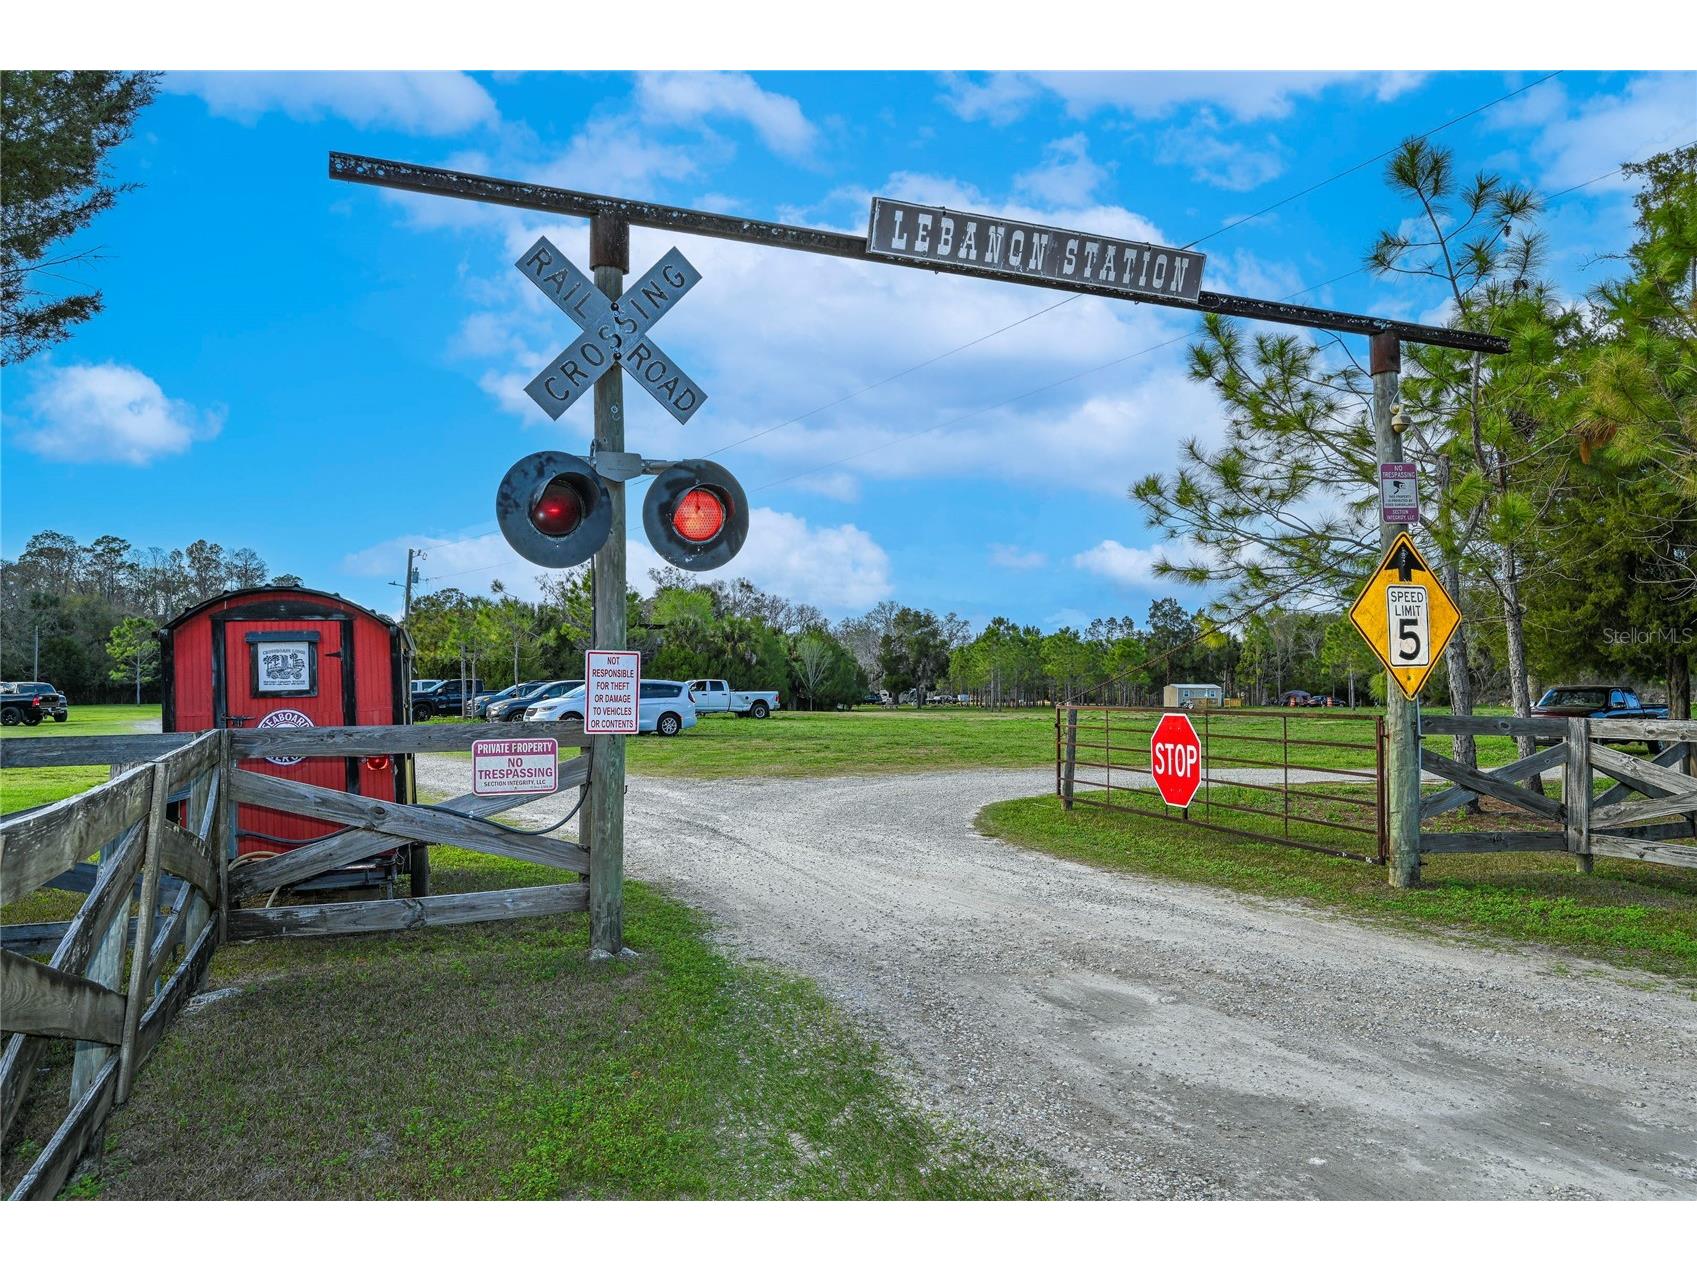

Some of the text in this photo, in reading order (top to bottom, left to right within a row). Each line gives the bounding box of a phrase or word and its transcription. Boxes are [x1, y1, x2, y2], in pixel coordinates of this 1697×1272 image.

[891, 210, 1190, 293] LEBANON STATION
[526, 247, 696, 412] RAIL ROAD
[544, 264, 685, 401] CROSSING
[1390, 591, 1424, 603] SPEED
[1395, 605, 1421, 617] LIMIT
[1398, 618, 1421, 661] 5
[607, 656, 620, 665] NOT
[592, 669, 634, 678] RESPONSIBLE
[596, 682, 629, 690] FOR THEFT
[594, 694, 631, 703] OR DAMAGE
[593, 706, 632, 716] TO VEHICLES
[590, 720, 634, 728] OR CONTENTS
[477, 742, 552, 754] PRIVATE PROPERTY
[508, 758, 523, 768] NO
[1155, 742, 1198, 778] STOP
[478, 768, 553, 780] TRESPASSING
